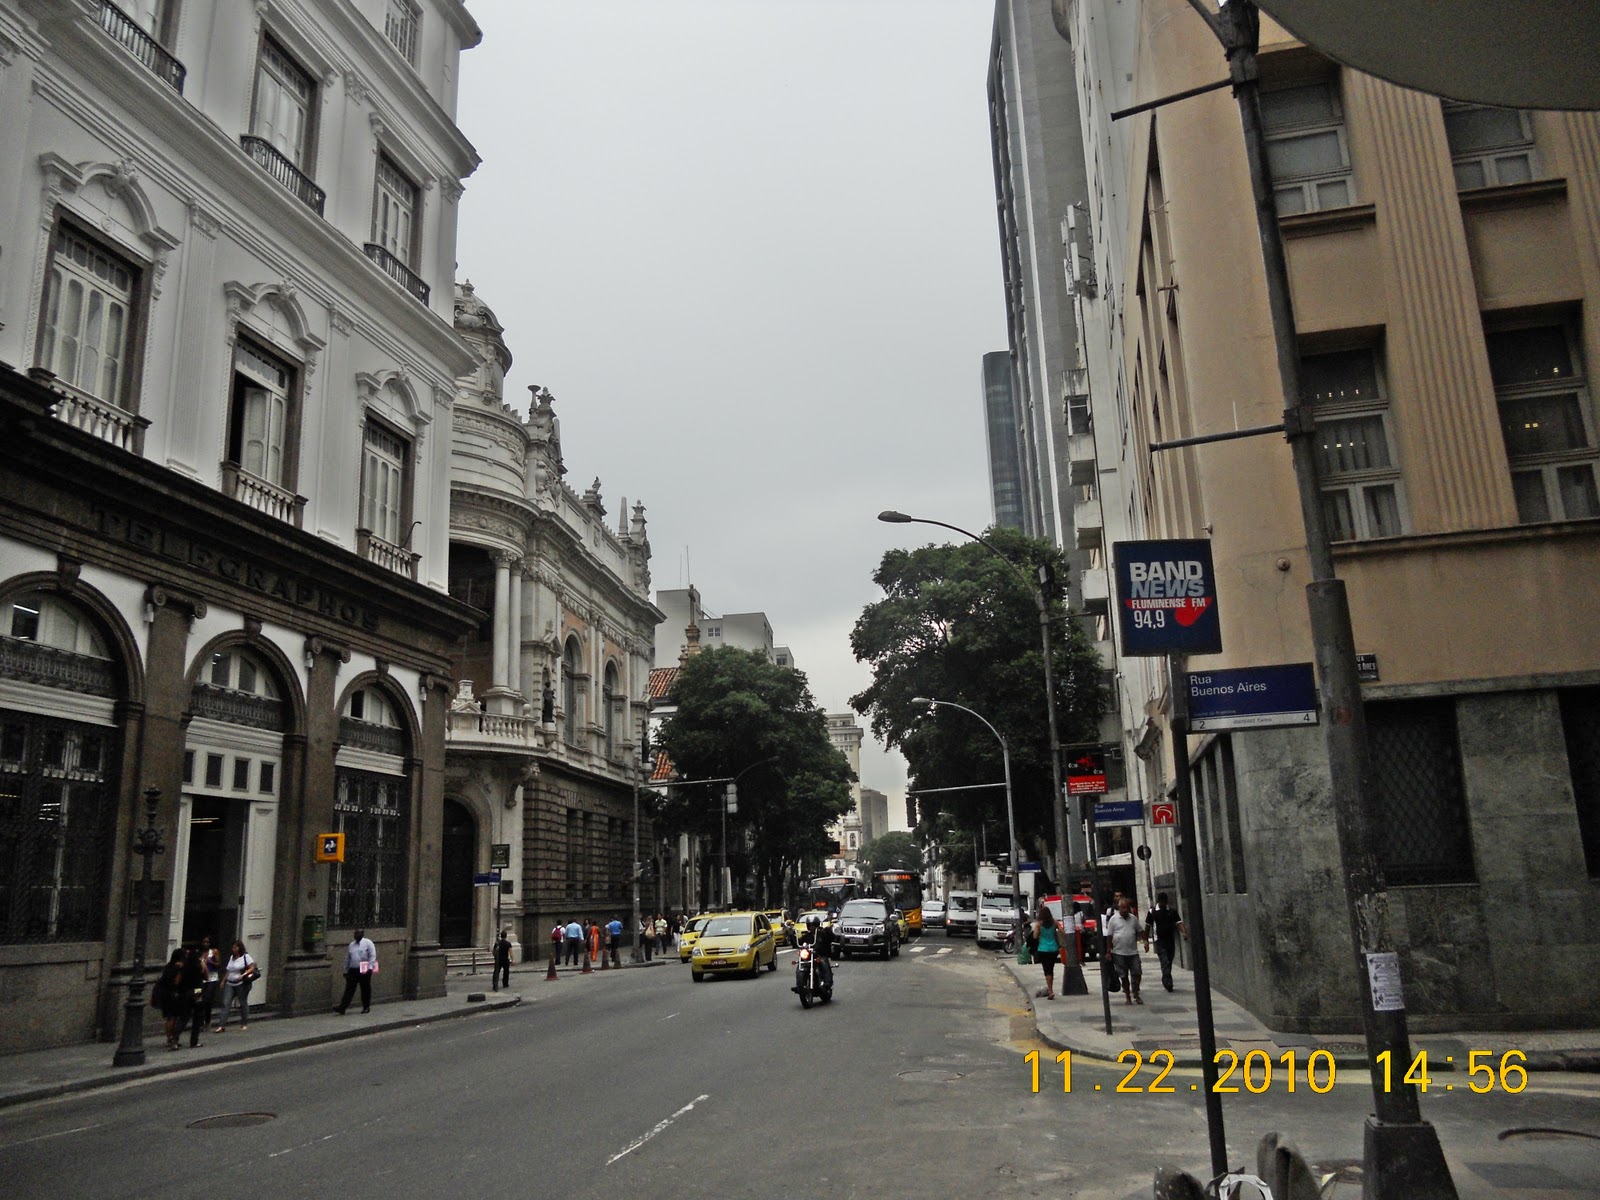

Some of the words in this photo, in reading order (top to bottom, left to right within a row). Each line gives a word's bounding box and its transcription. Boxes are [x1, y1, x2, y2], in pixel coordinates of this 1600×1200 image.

[92, 504, 379, 630] TELEGRAPHOS
[1129, 560, 1203, 582] BAND
[1130, 579, 1205, 598] NEWS
[1131, 598, 1187, 609] FLUMINENSE
[1191, 596, 1206, 608] FM
[1134, 609, 1166, 629] 94,9
[1190, 675, 1212, 686] Rua
[1191, 684, 1234, 697] Buenos
[1237, 681, 1267, 693] Aires
[1199, 720, 1206, 730] 2
[1303, 714, 1310, 722] 4
